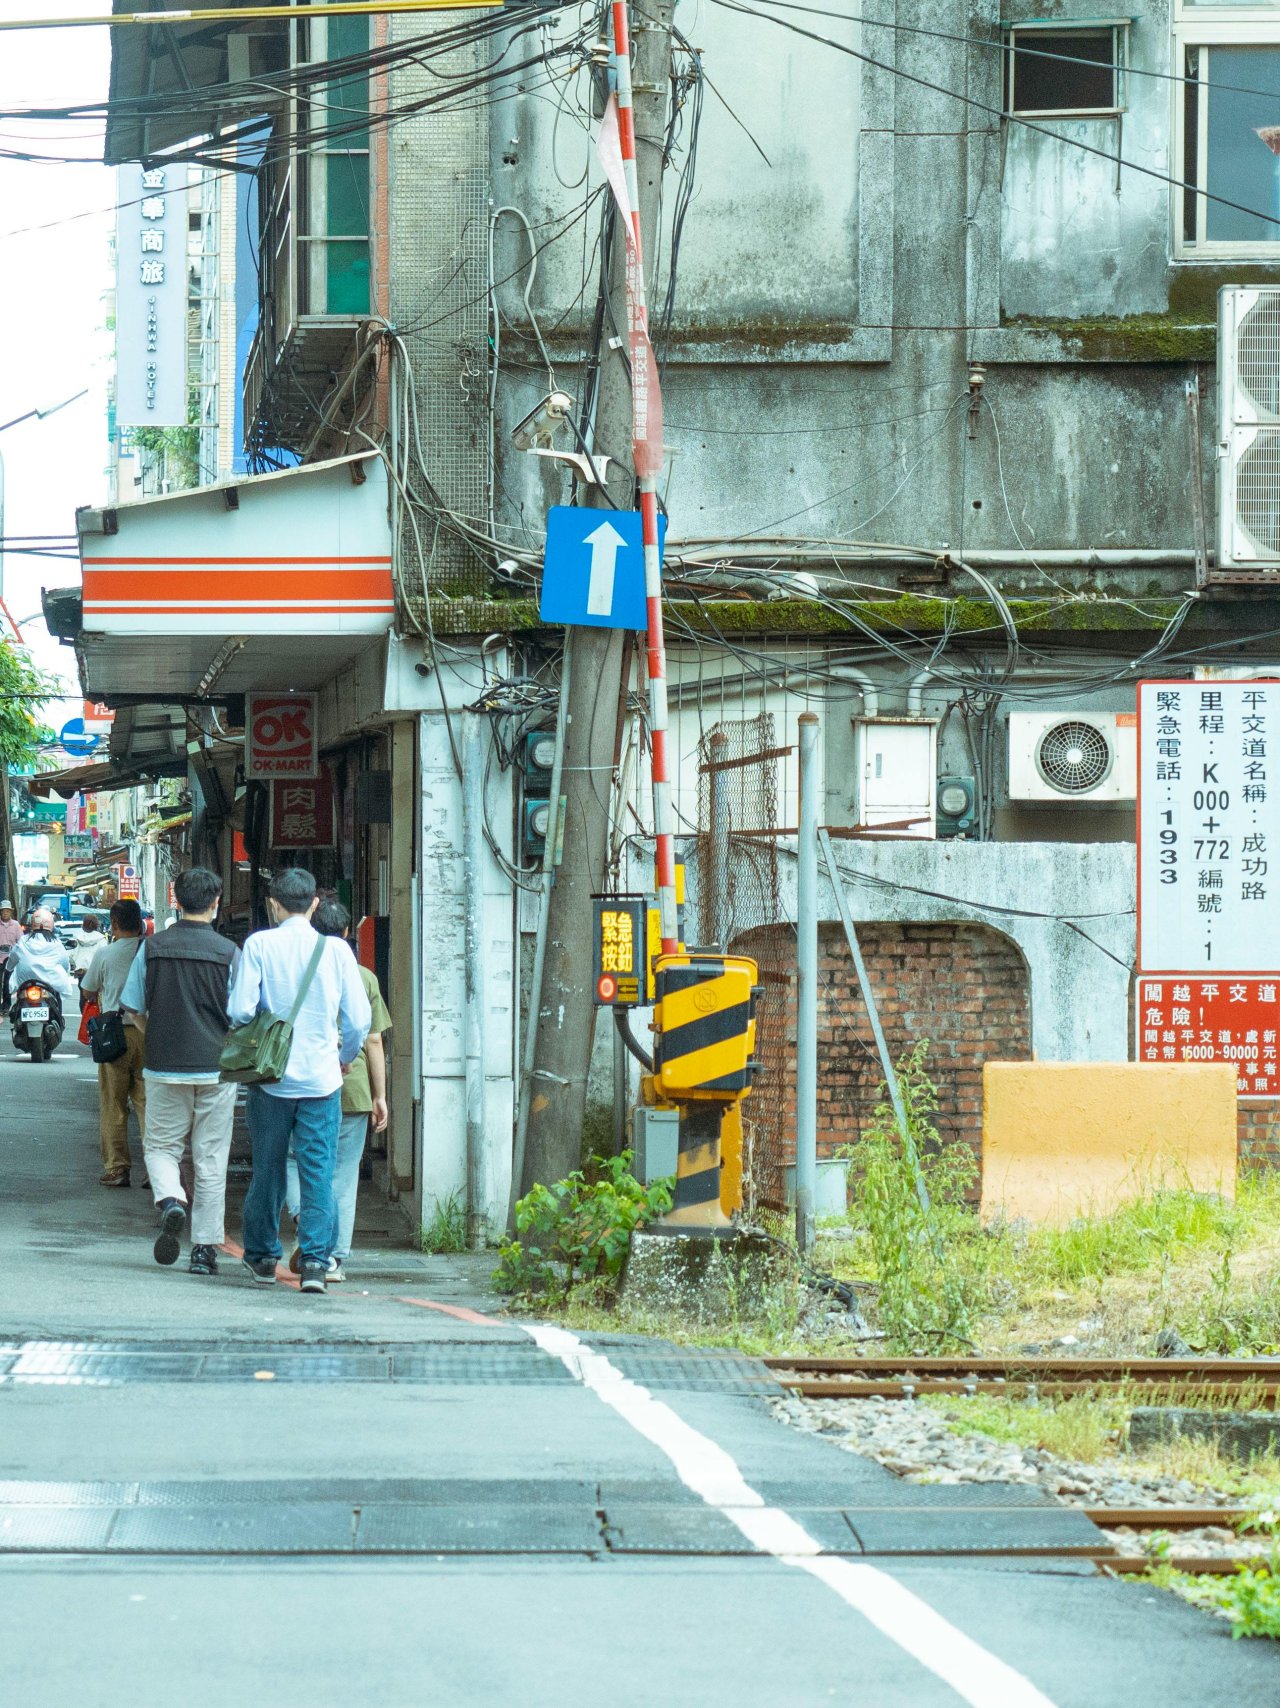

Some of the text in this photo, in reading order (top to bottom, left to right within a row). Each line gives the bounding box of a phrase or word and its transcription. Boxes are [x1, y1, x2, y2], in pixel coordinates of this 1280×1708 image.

[140, 169, 166, 285] 金華商旅
[146, 296, 157, 410] JINHWA HOTEL
[253, 708, 311, 747] OK
[282, 786, 317, 839] 肉鬆
[1144, 984, 1278, 1003] 闖越平交道
